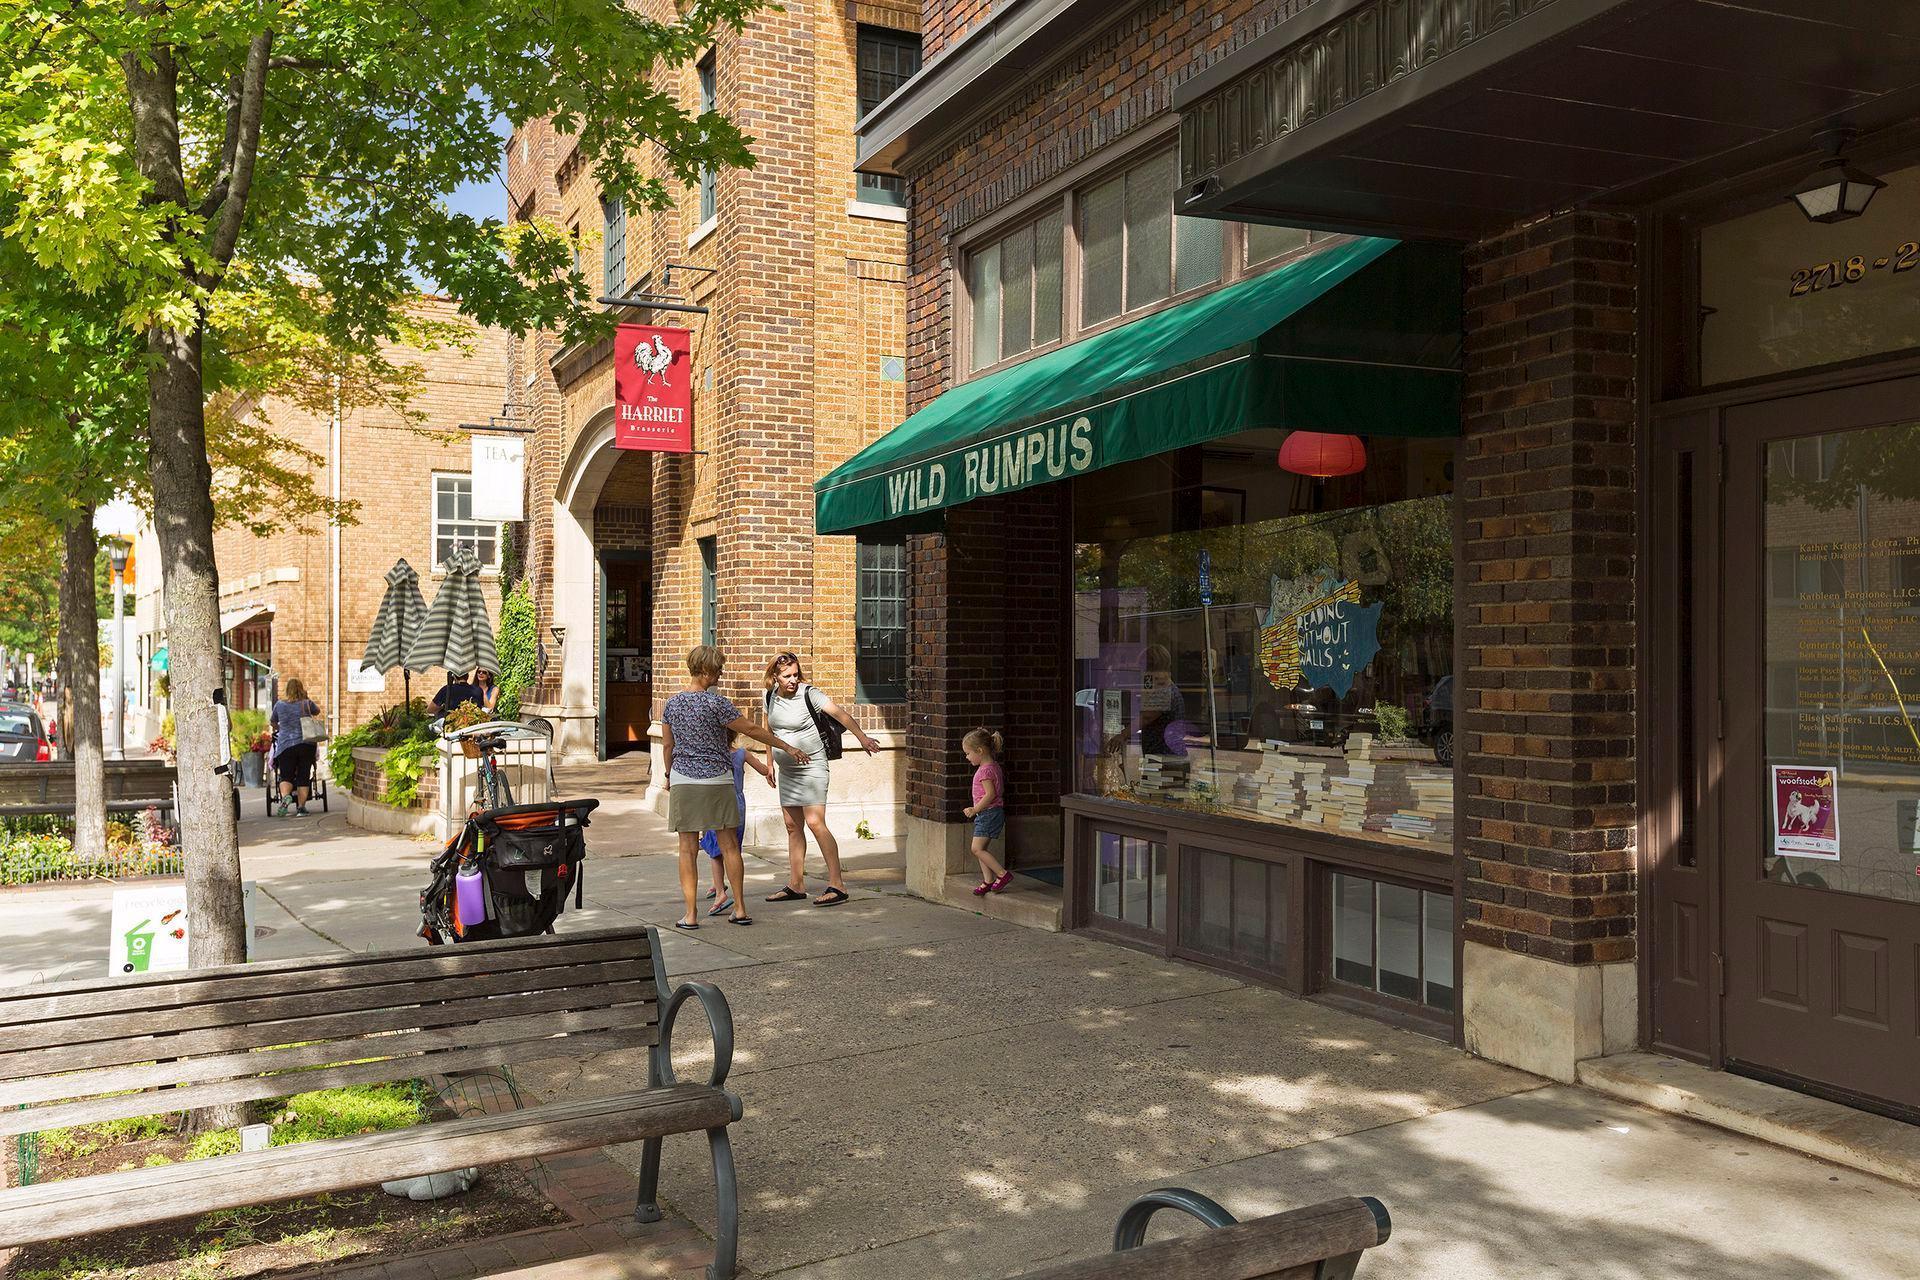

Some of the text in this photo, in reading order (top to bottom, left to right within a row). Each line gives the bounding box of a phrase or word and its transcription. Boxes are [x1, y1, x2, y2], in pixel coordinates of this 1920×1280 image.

[621, 404, 684, 423] HARRIET
[630, 425, 675, 433] Brasserie
[484, 446, 508, 461] TEA
[889, 416, 1093, 514] WILD RUMPUS
[1799, 543, 1829, 553] Kathie
[1799, 592, 1840, 600] Kathleen
[1297, 620, 1350, 648] WITHOUT
[1799, 640, 1828, 650] Center
[1299, 648, 1334, 668] WALLS
[1799, 691, 1834, 699] Elizabeth
[1799, 713, 1821, 722] Elise
[1824, 713, 1865, 725] Sanders,
[1779, 776, 1817, 785] woofstock
